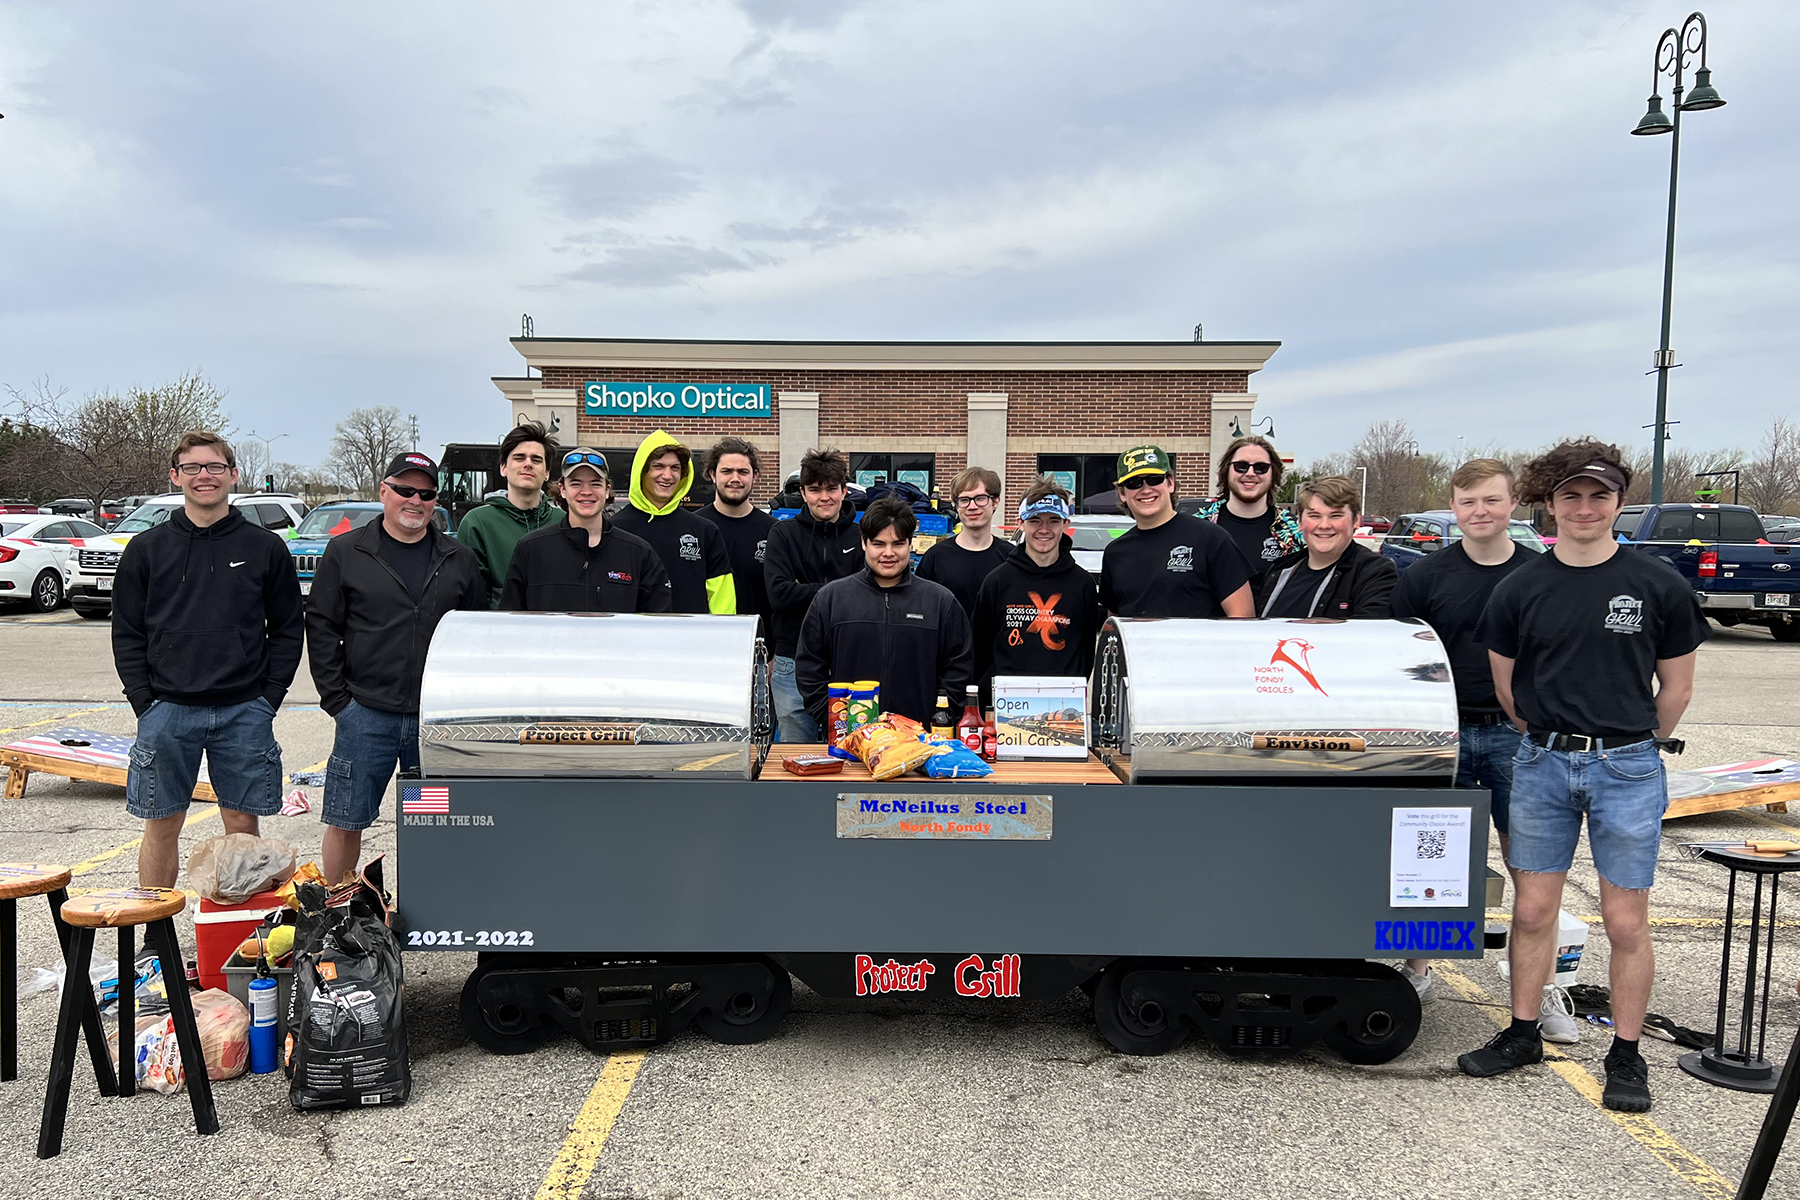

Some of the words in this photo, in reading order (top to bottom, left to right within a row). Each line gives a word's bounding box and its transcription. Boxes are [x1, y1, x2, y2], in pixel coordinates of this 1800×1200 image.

[587, 384, 676, 413] Shopko
[1605, 612, 1643, 627] GRILL
[1256, 686, 1294, 694] ORIOLES
[996, 698, 1029, 713] Open
[525, 731, 586, 743] Project
[590, 731, 631, 741] Grill
[997, 733, 1022, 746] Coil
[1027, 733, 1061, 746] Cars
[1265, 737, 1350, 750] Envision
[859, 800, 960, 814] McNeilus
[975, 802, 1027, 815] Steel
[403, 815, 434, 826] MADE
[435, 815, 448, 826] IN
[449, 815, 470, 826] THE
[472, 815, 495, 826] USA
[899, 821, 944, 833] North
[947, 822, 991, 834] Fondy
[407, 930, 534, 946] 2021-2022
[1374, 921, 1476, 951] KONDEX
[955, 954, 1021, 997] Grill
